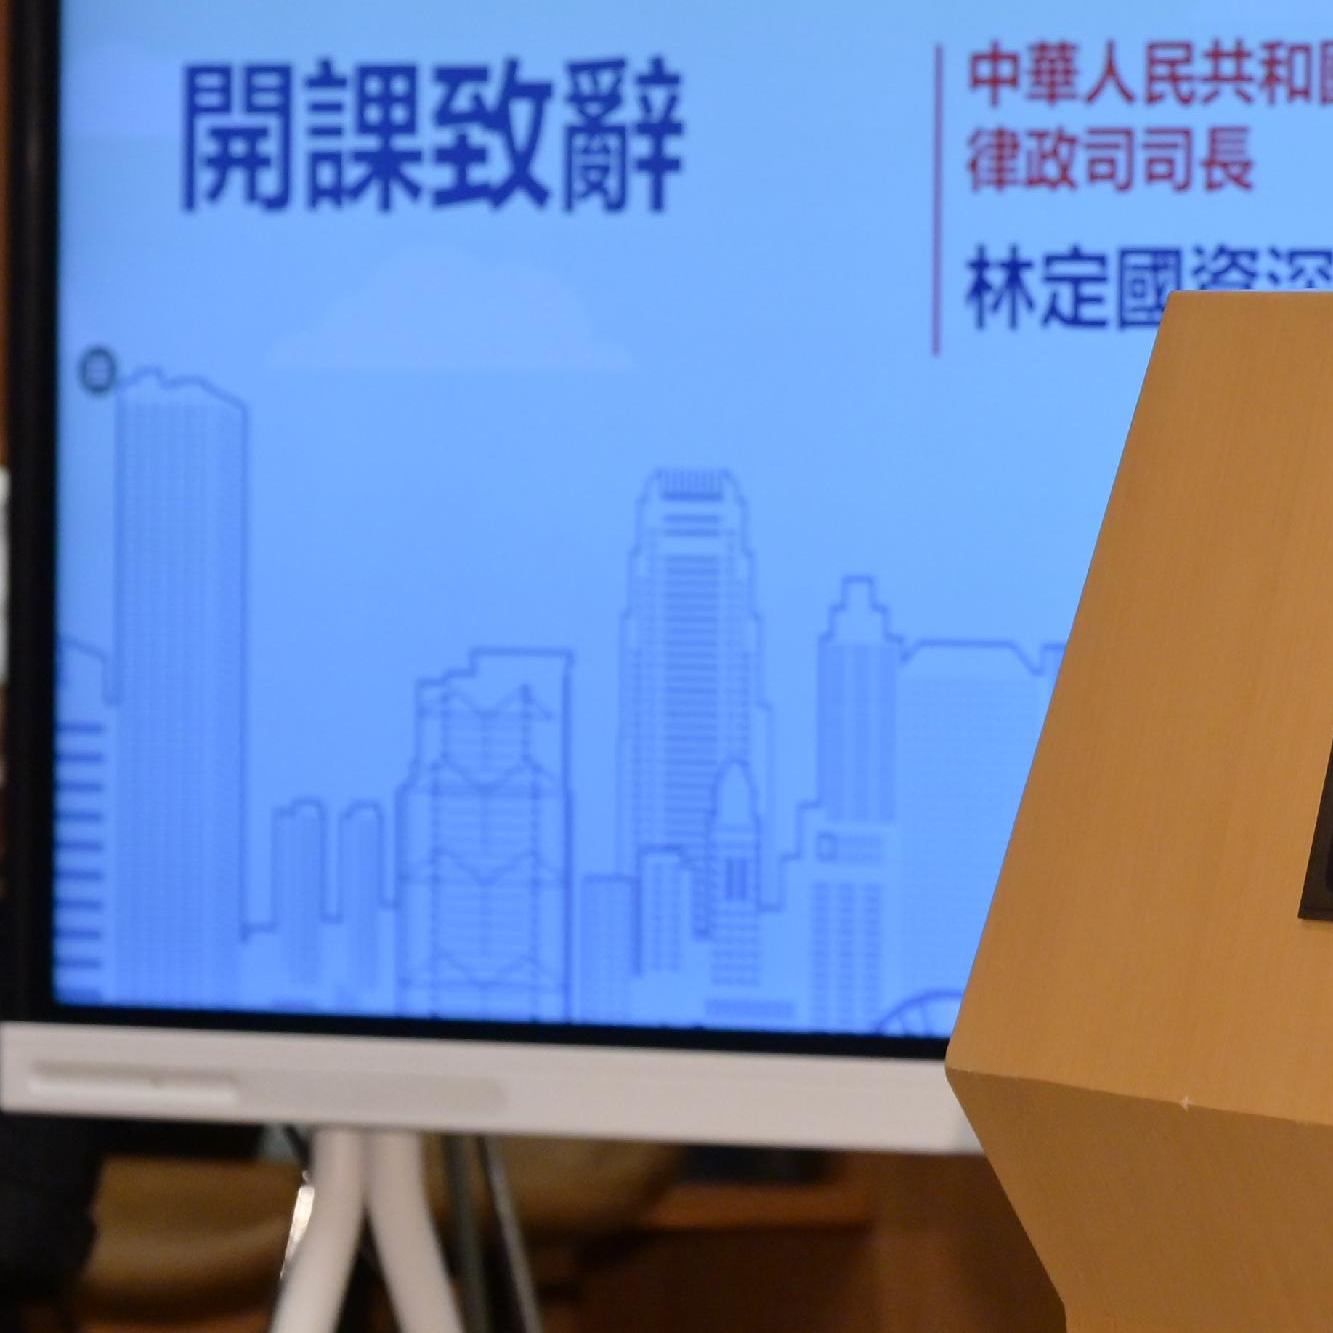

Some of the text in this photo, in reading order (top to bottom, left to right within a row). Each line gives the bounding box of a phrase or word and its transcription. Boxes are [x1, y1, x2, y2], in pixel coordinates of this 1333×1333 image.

[181, 55, 686, 214] 開課致辭
[967, 125, 1254, 193] 律政司司長
